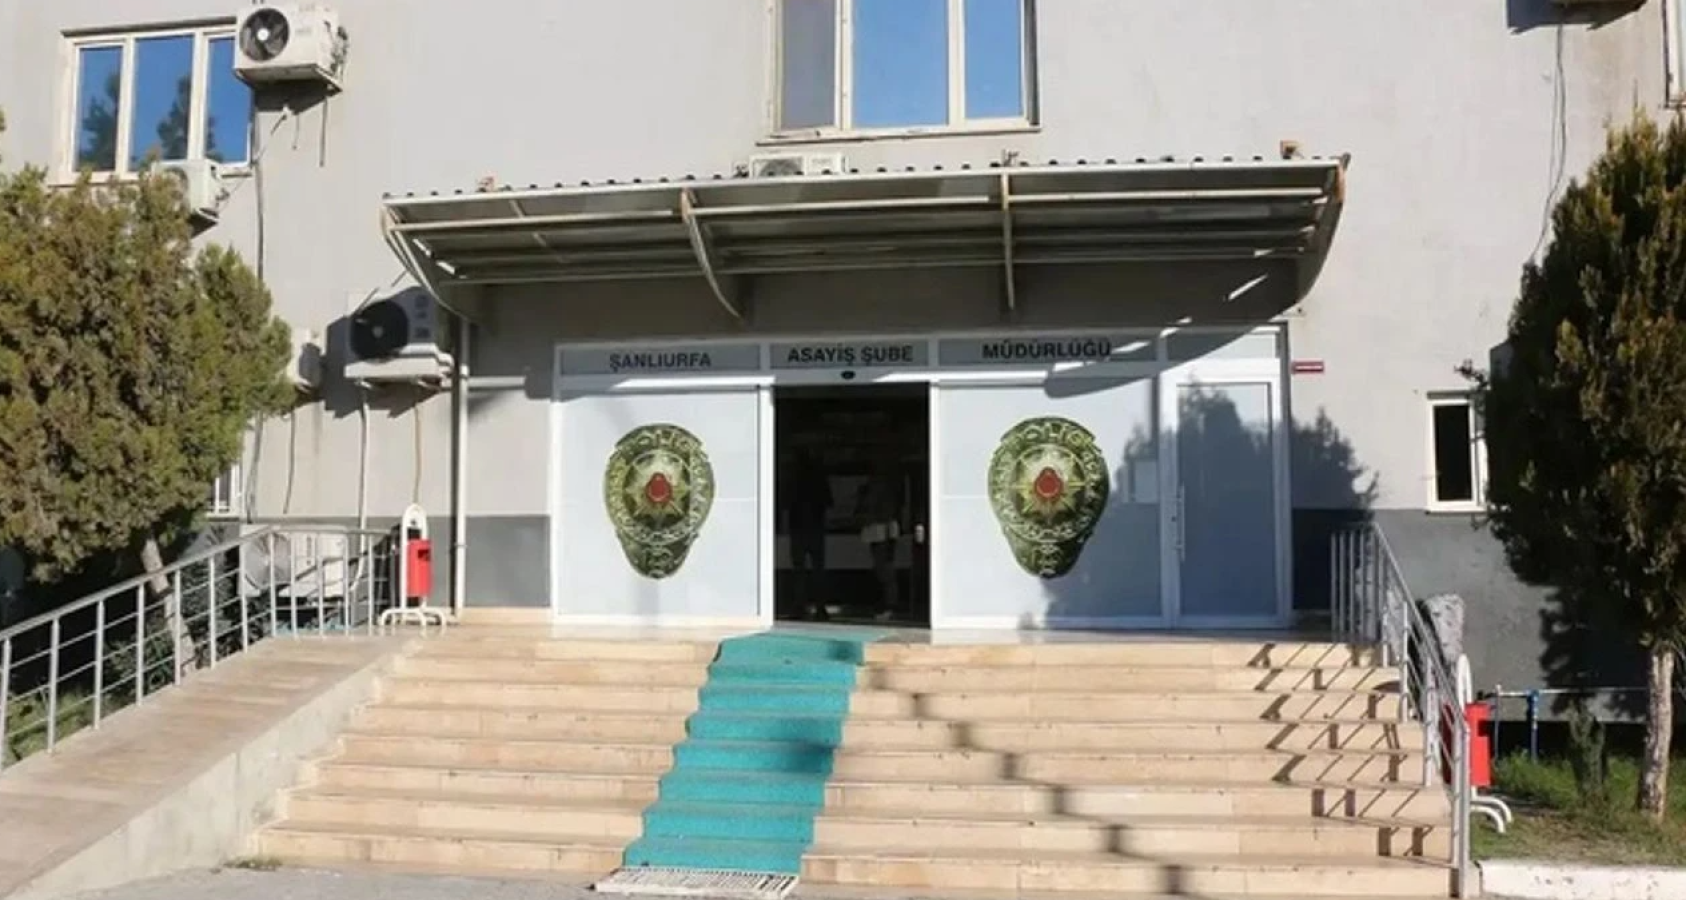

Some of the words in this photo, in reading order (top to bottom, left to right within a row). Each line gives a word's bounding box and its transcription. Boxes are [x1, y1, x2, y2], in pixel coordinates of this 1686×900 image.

[609, 352, 712, 373] ŞANLIURFA
[788, 342, 856, 366] ASAYİŞ
[860, 345, 914, 366] ŞUBE
[982, 338, 1112, 359] MÜDÜRLÜĞÜ
